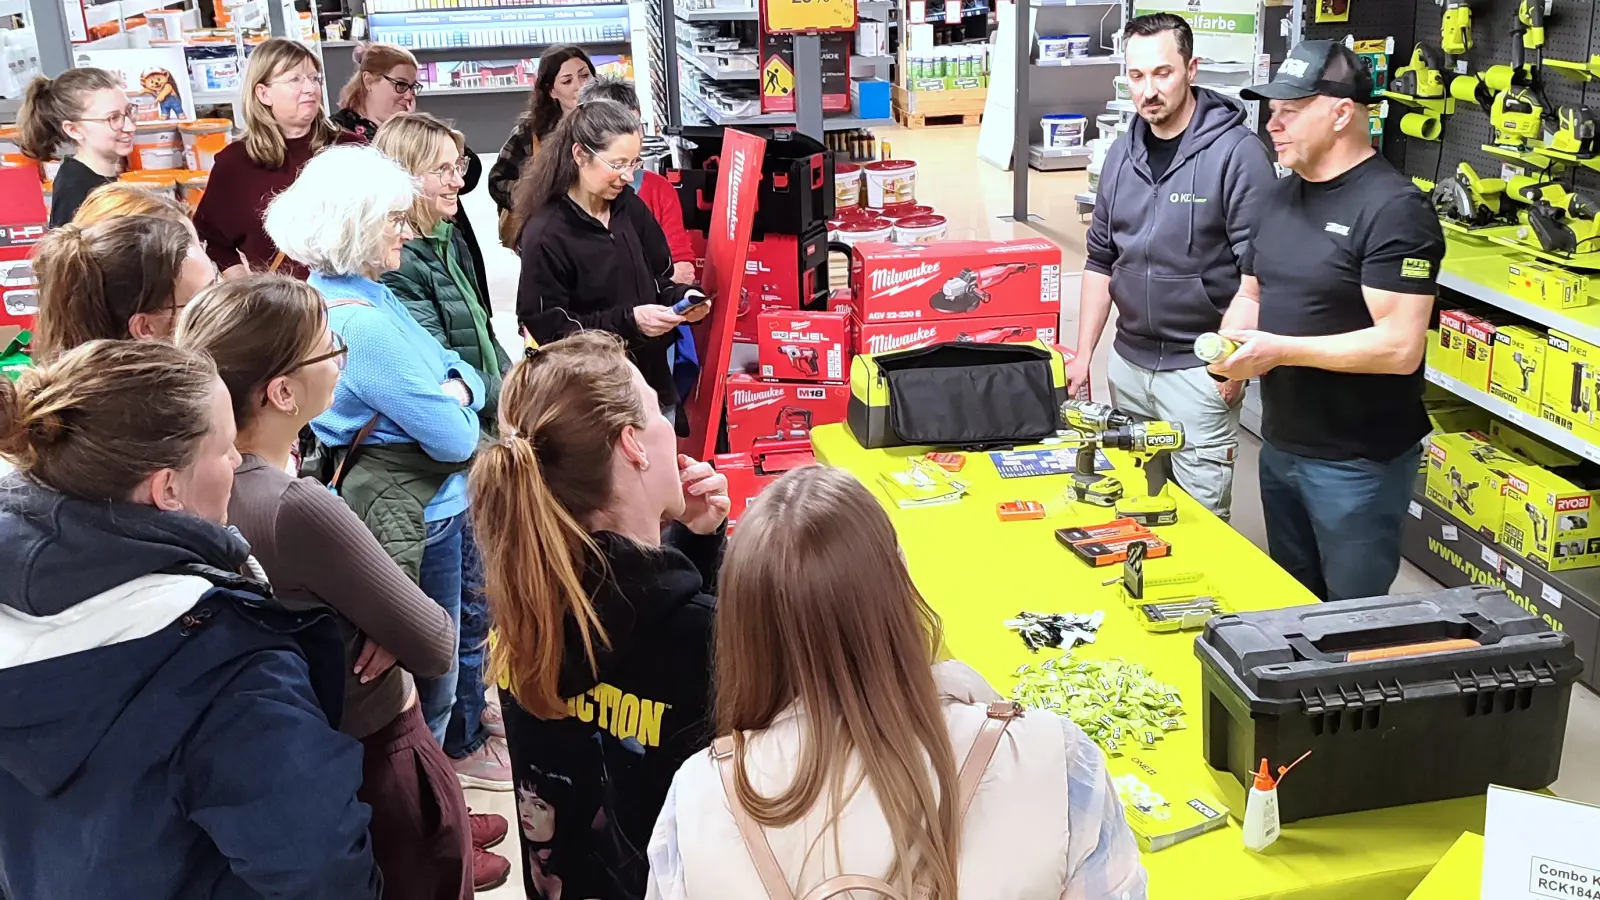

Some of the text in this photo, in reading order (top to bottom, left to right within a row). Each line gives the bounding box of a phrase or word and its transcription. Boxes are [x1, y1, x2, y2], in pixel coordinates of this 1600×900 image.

[1188, 14, 1237, 32] elfarbe
[728, 147, 747, 242] Milwaukee
[745, 260, 771, 272] EL
[868, 261, 941, 292] Milwaukee
[868, 310, 922, 320] AGV 22-230 E
[1441, 314, 1460, 331] RYOBI
[789, 331, 830, 342] FUEL
[865, 326, 937, 355] Milwaukee
[1466, 324, 1486, 341] RYOBI
[1495, 332, 1511, 345] RYOBI
[1548, 336, 1569, 352] RYOBI
[731, 387, 824, 406] Milwaukee M18
[1147, 435, 1174, 446] RYOBI
[1508, 475, 1529, 496] RYOBI
[1557, 497, 1590, 511] RYOBI
[1188, 798, 1219, 819] RYOBI
[1539, 863, 1588, 884] Combo
